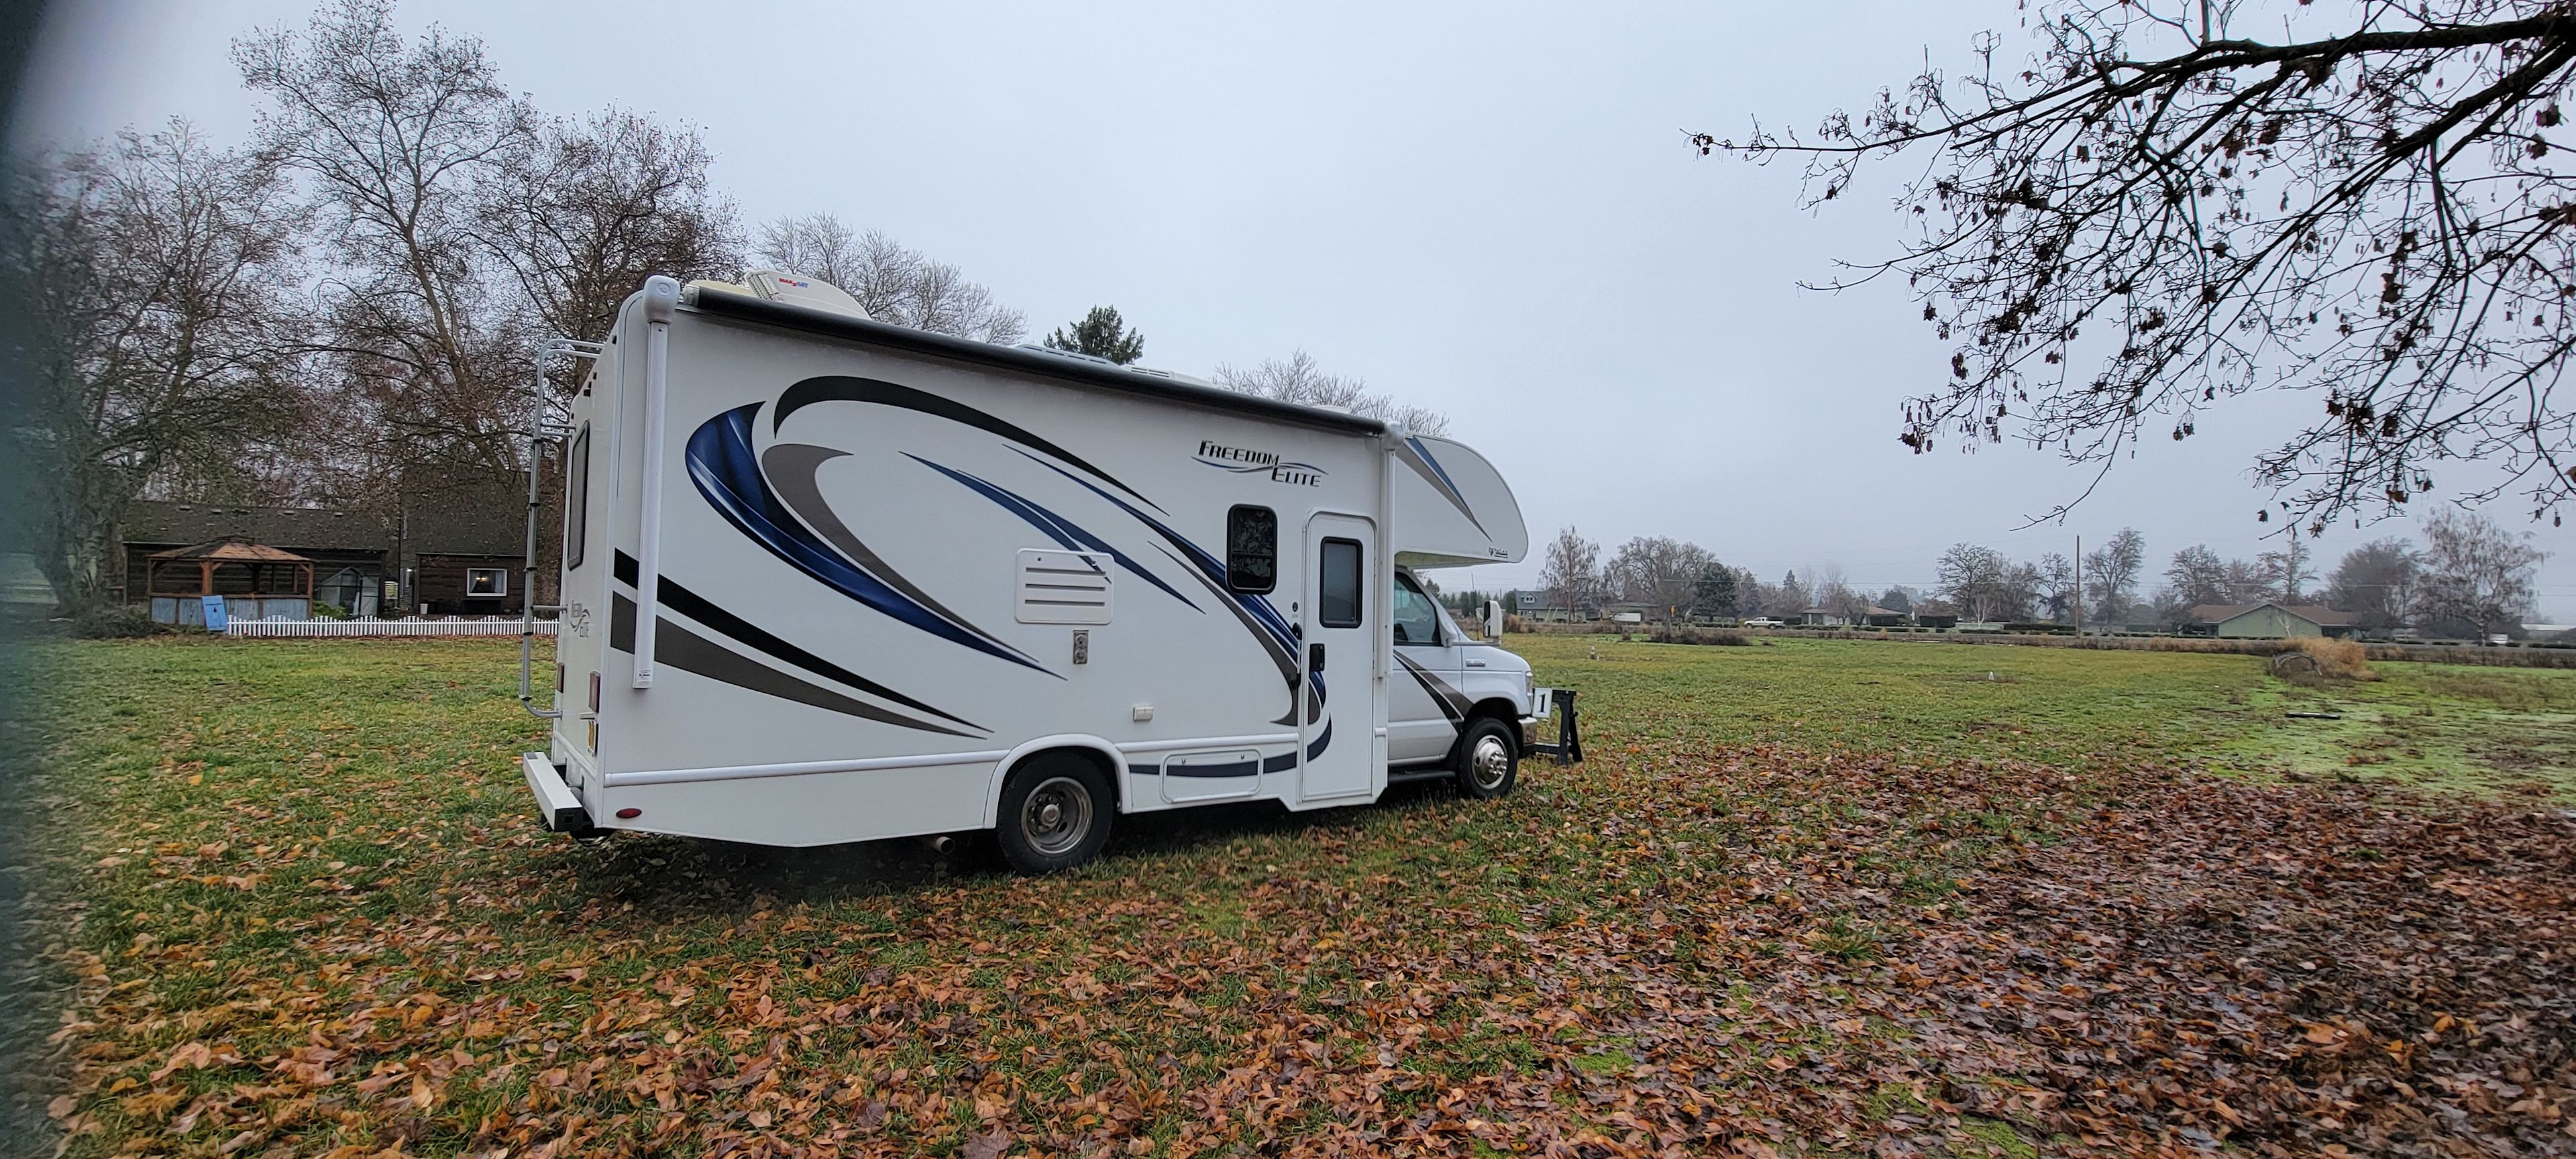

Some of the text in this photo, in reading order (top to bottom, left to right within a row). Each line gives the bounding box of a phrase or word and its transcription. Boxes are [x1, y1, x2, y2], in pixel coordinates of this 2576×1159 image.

[1198, 440, 1279, 465] FREEDOM
[1271, 467, 1321, 487] ELITE
[1537, 693, 1546, 713] 1
